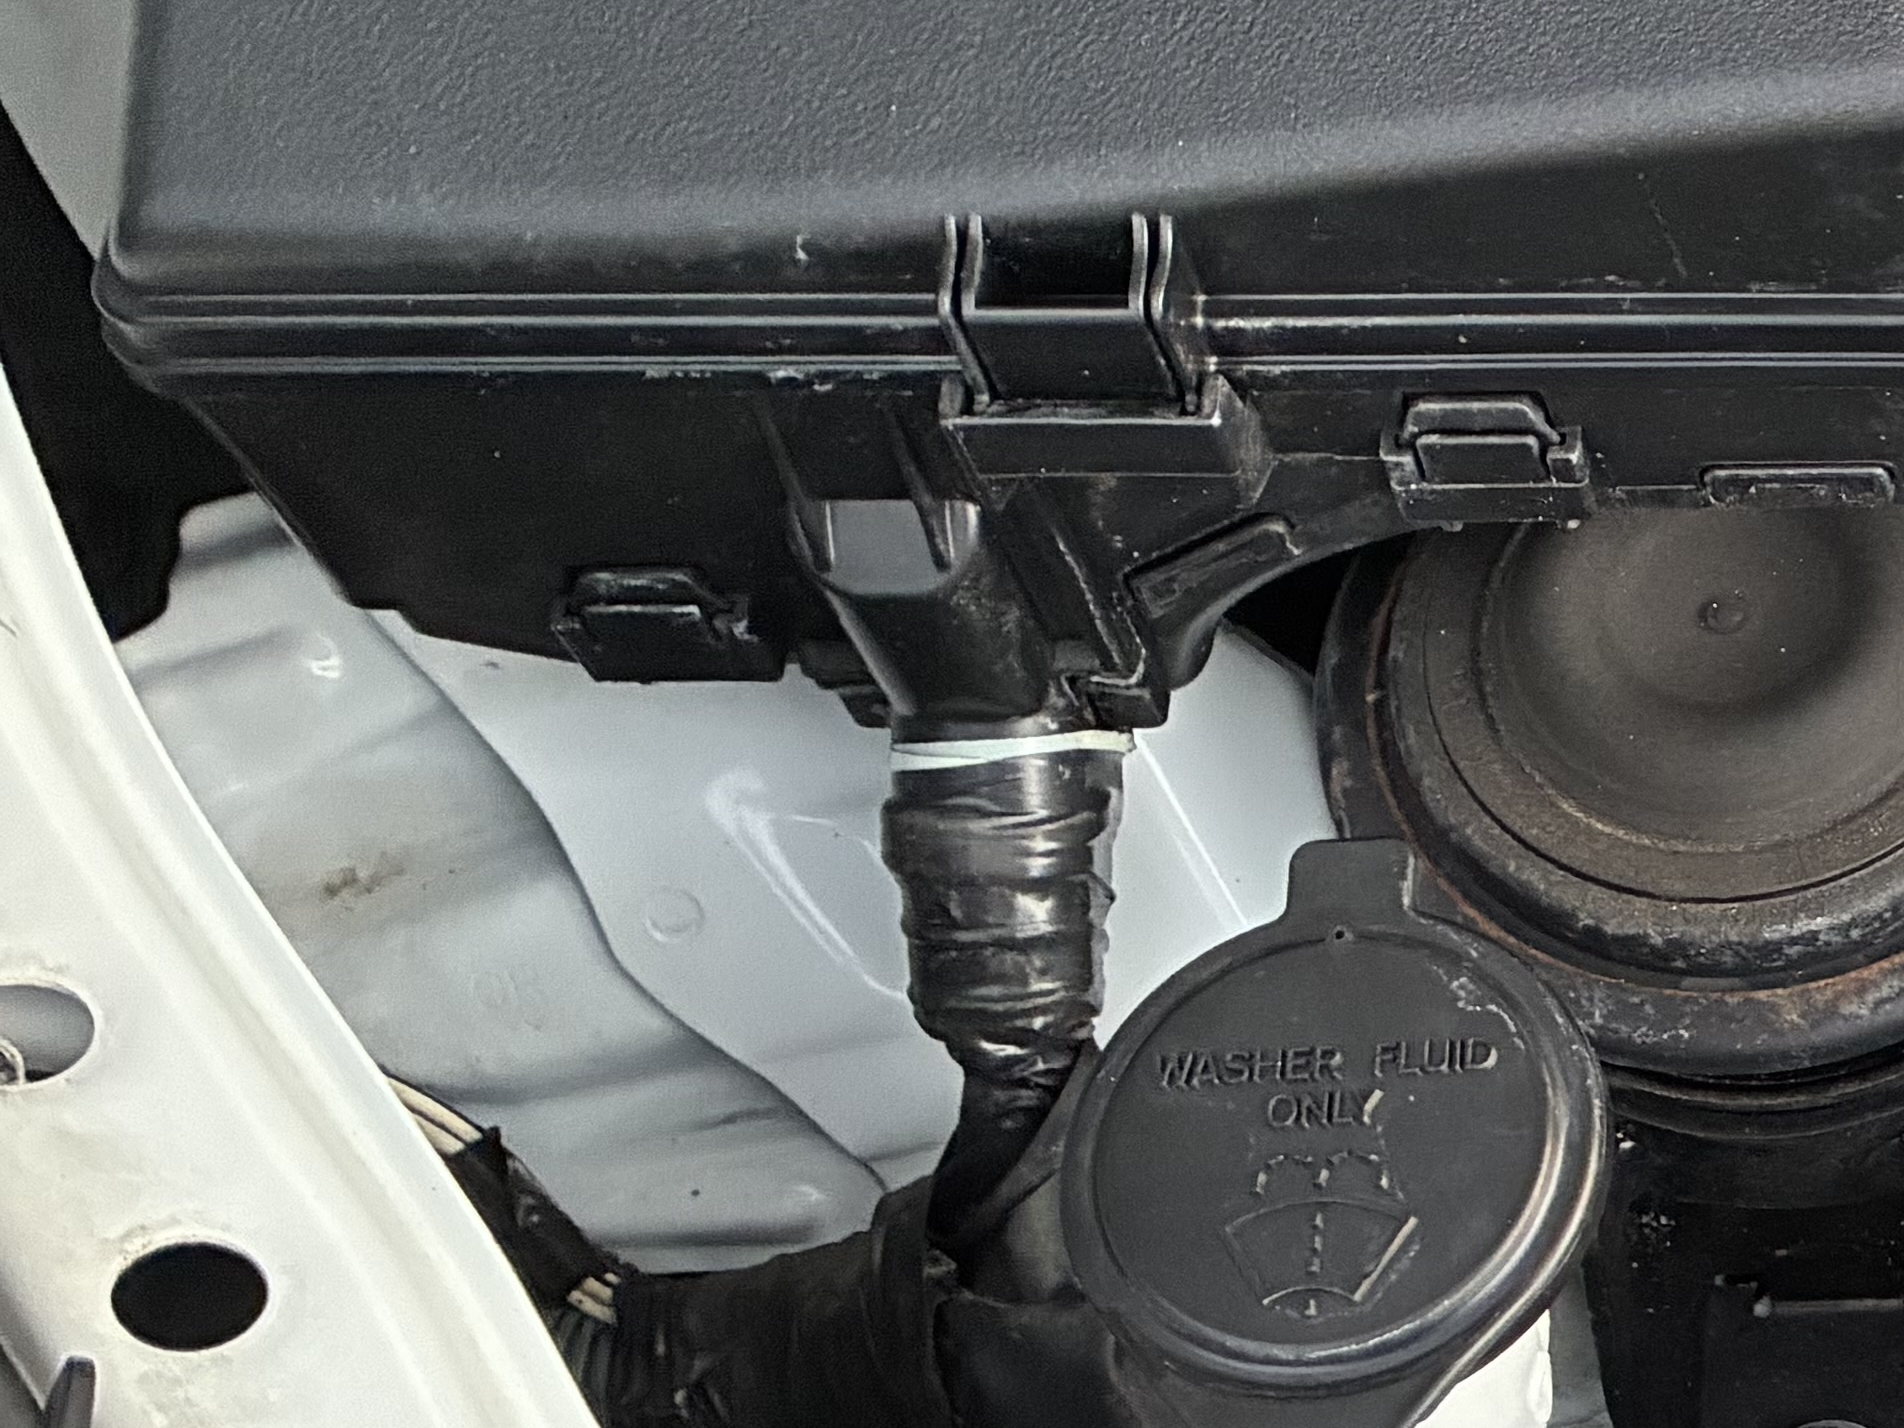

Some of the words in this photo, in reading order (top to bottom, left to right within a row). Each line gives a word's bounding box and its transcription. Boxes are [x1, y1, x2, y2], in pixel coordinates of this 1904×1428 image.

[1156, 1044, 1344, 1090] WASHER
[1373, 1037, 1498, 1078] FLUID
[1266, 1088, 1385, 1129] ONLY
